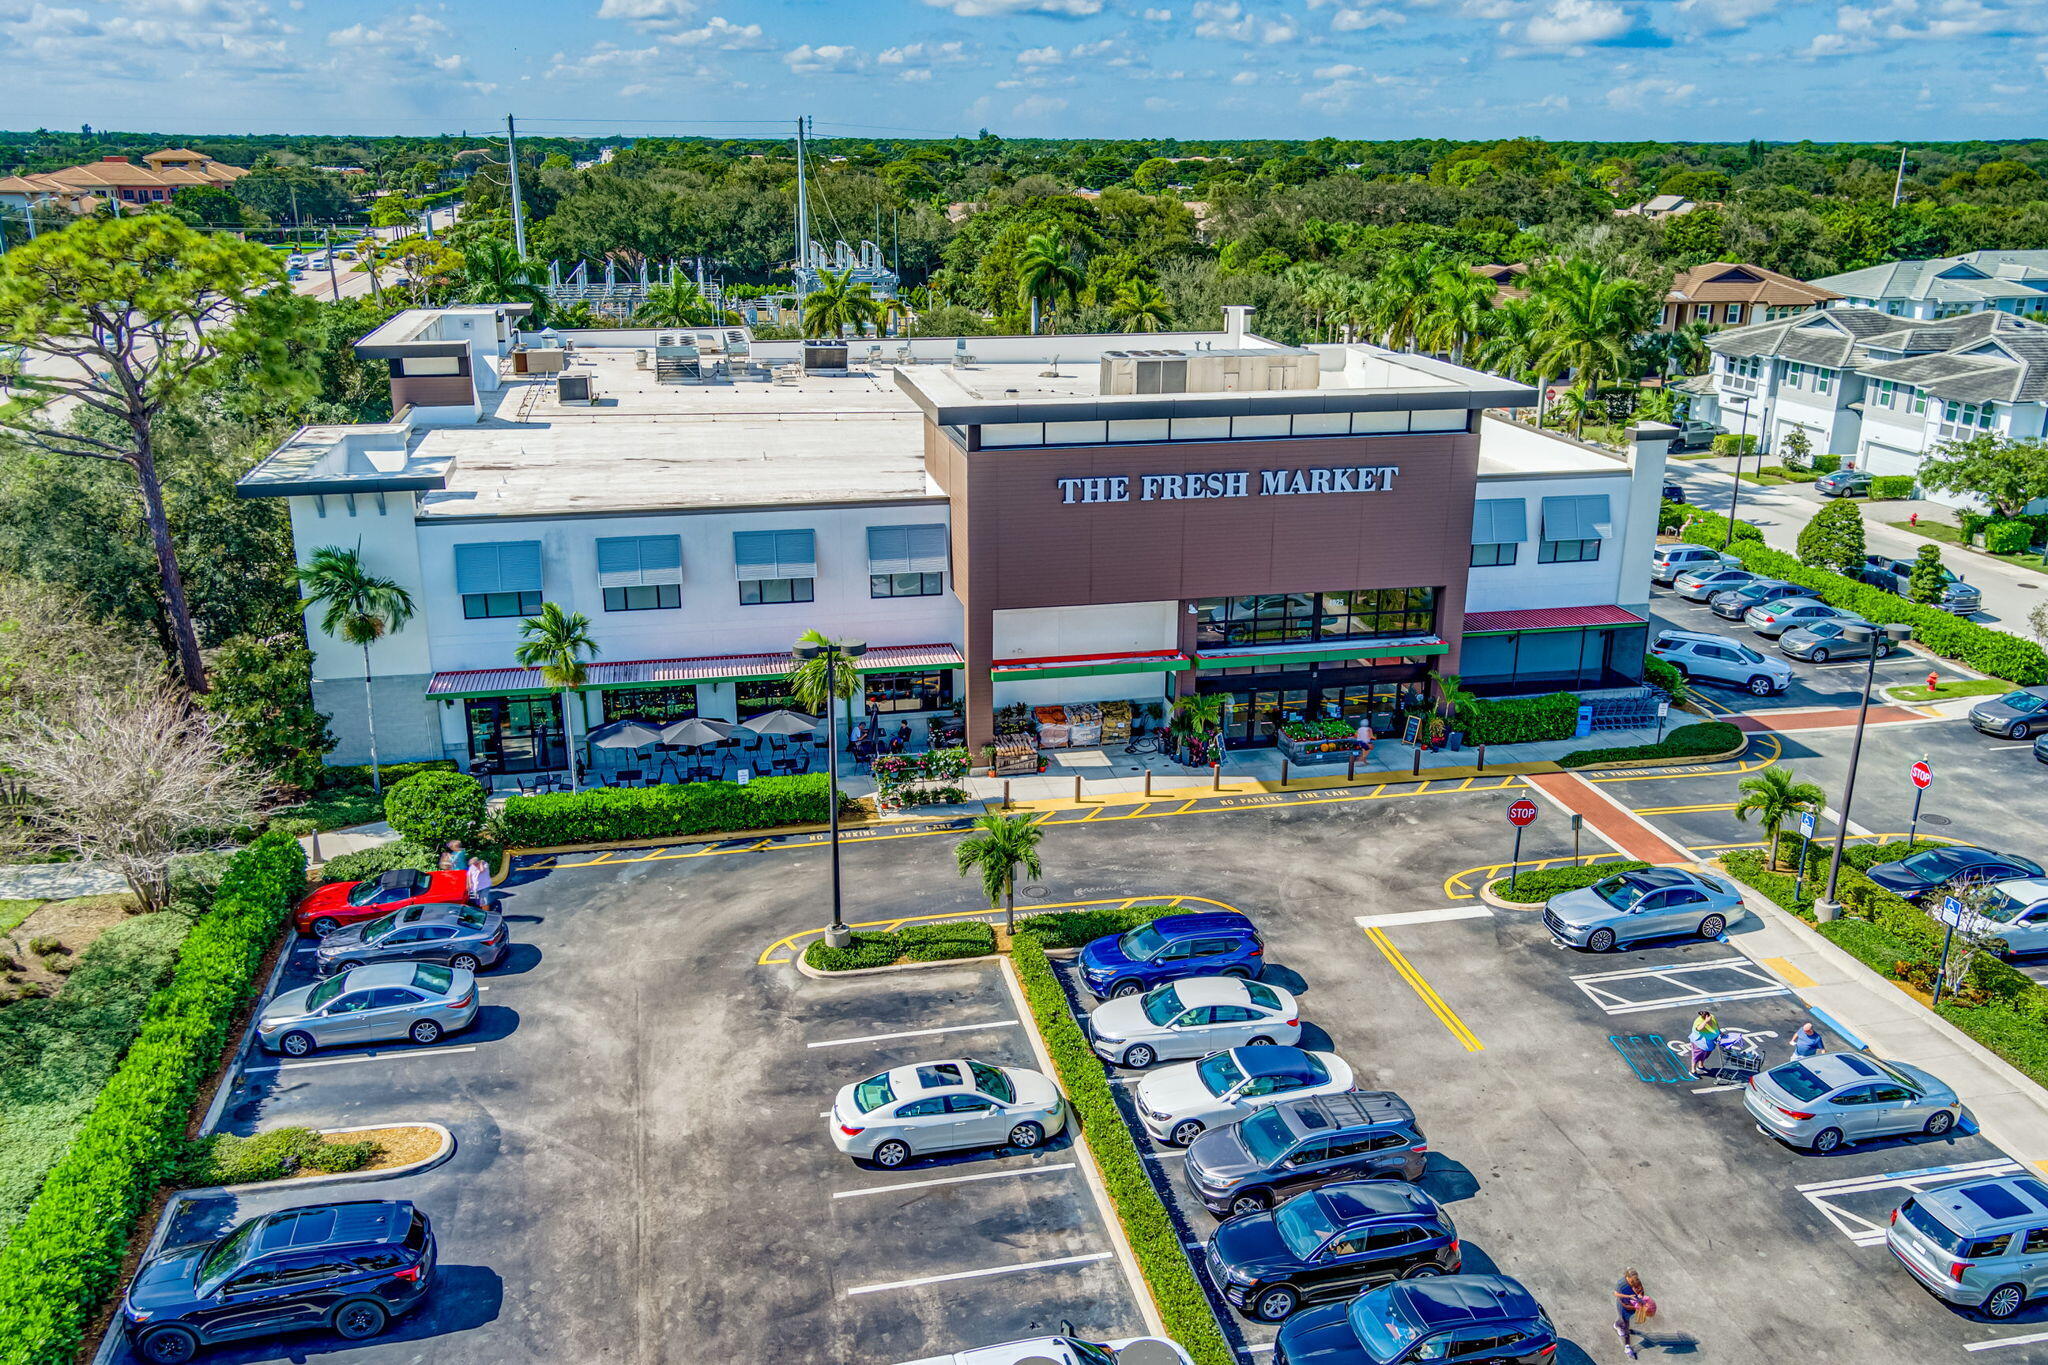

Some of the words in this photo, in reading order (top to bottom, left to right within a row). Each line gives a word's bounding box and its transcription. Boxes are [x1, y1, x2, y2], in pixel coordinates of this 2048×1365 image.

[1058, 476, 1130, 504] THE
[1140, 472, 1250, 501] FRESH
[1260, 466, 1399, 496] MARKET
[1910, 766, 1930, 782] STOP
[1240, 795, 1283, 804] PARKING
[1297, 791, 1320, 799] FIRE
[1326, 789, 1352, 797] LANE
[1510, 808, 1535, 819] STOP
[837, 830, 877, 839] ARKING
[895, 826, 918, 834] FIRE
